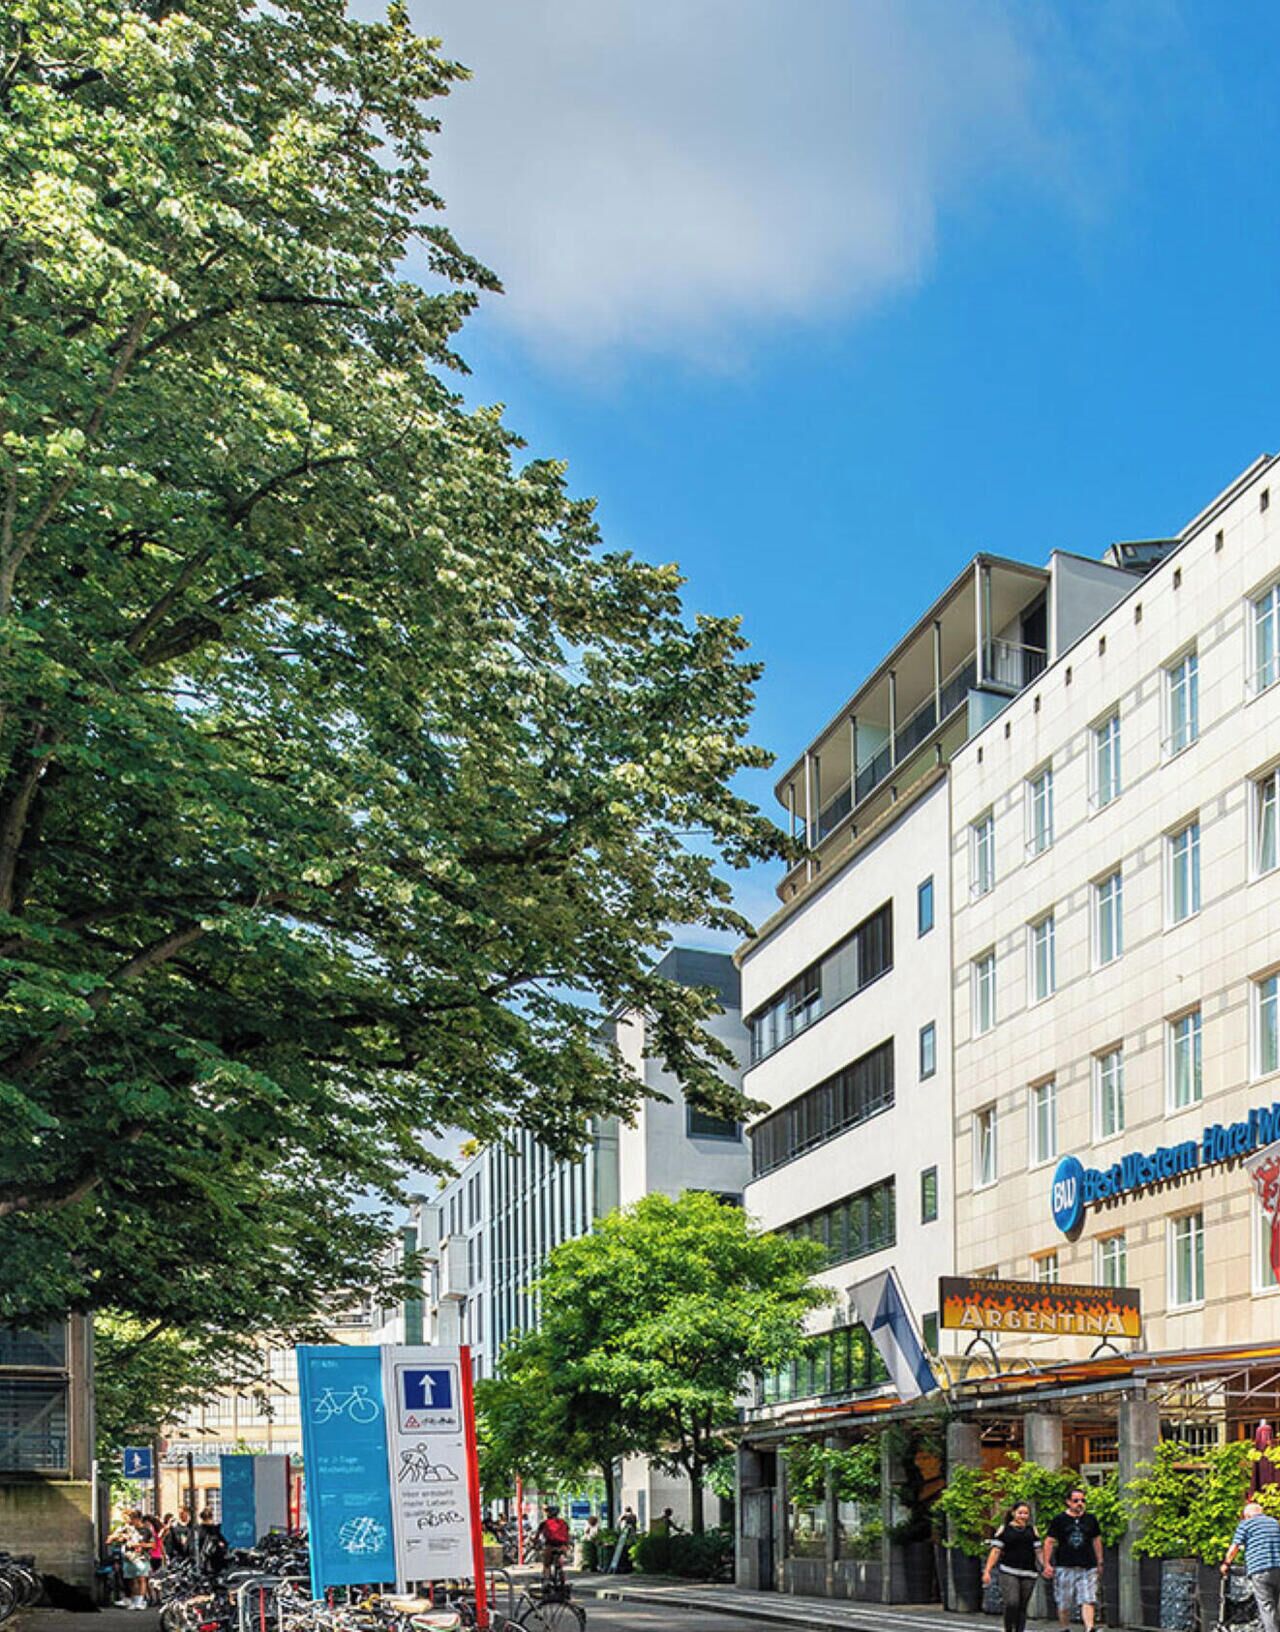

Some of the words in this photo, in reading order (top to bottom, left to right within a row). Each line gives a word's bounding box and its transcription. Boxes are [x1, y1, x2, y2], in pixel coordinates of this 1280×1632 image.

[1084, 1163, 1122, 1202] Best
[1122, 1141, 1198, 1190] Western
[1202, 1109, 1258, 1164] Hotel
[1054, 1177, 1076, 1213] BW
[968, 1280, 1038, 1295] STEAKHOUSE
[1040, 1285, 1049, 1295] &
[1051, 1285, 1115, 1299] RESTAURANT
[960, 1304, 1125, 1334] ARGENTINA
